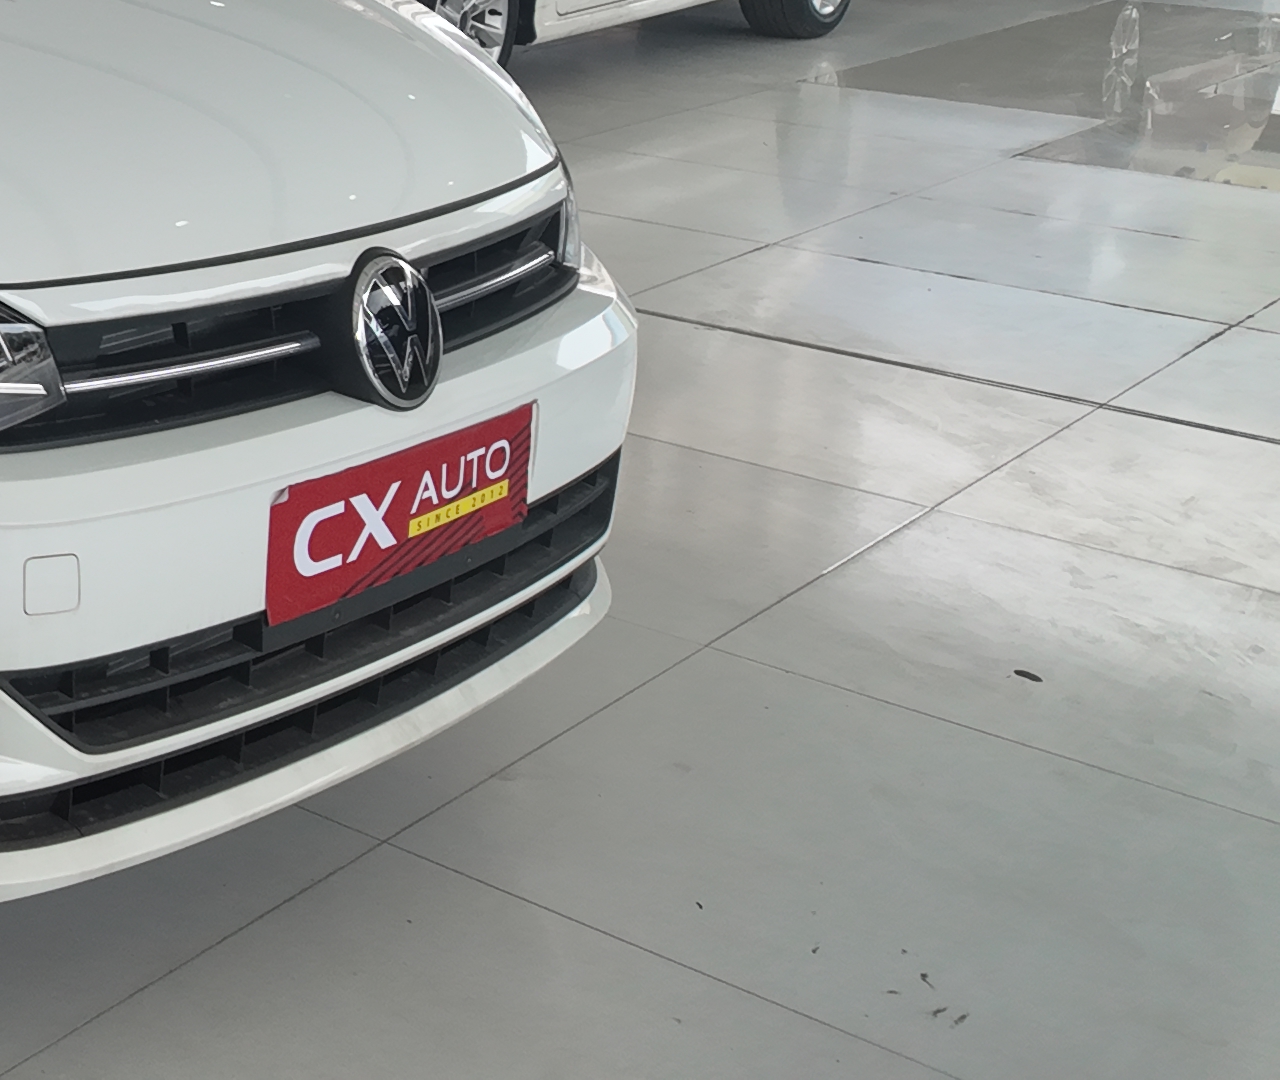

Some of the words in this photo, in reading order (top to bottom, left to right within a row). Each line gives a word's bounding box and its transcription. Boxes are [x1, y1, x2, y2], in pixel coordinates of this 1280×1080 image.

[293, 480, 402, 578] CX
[409, 439, 512, 516] AUTO
[415, 503, 462, 532] SINCE
[470, 484, 506, 509] 2012
